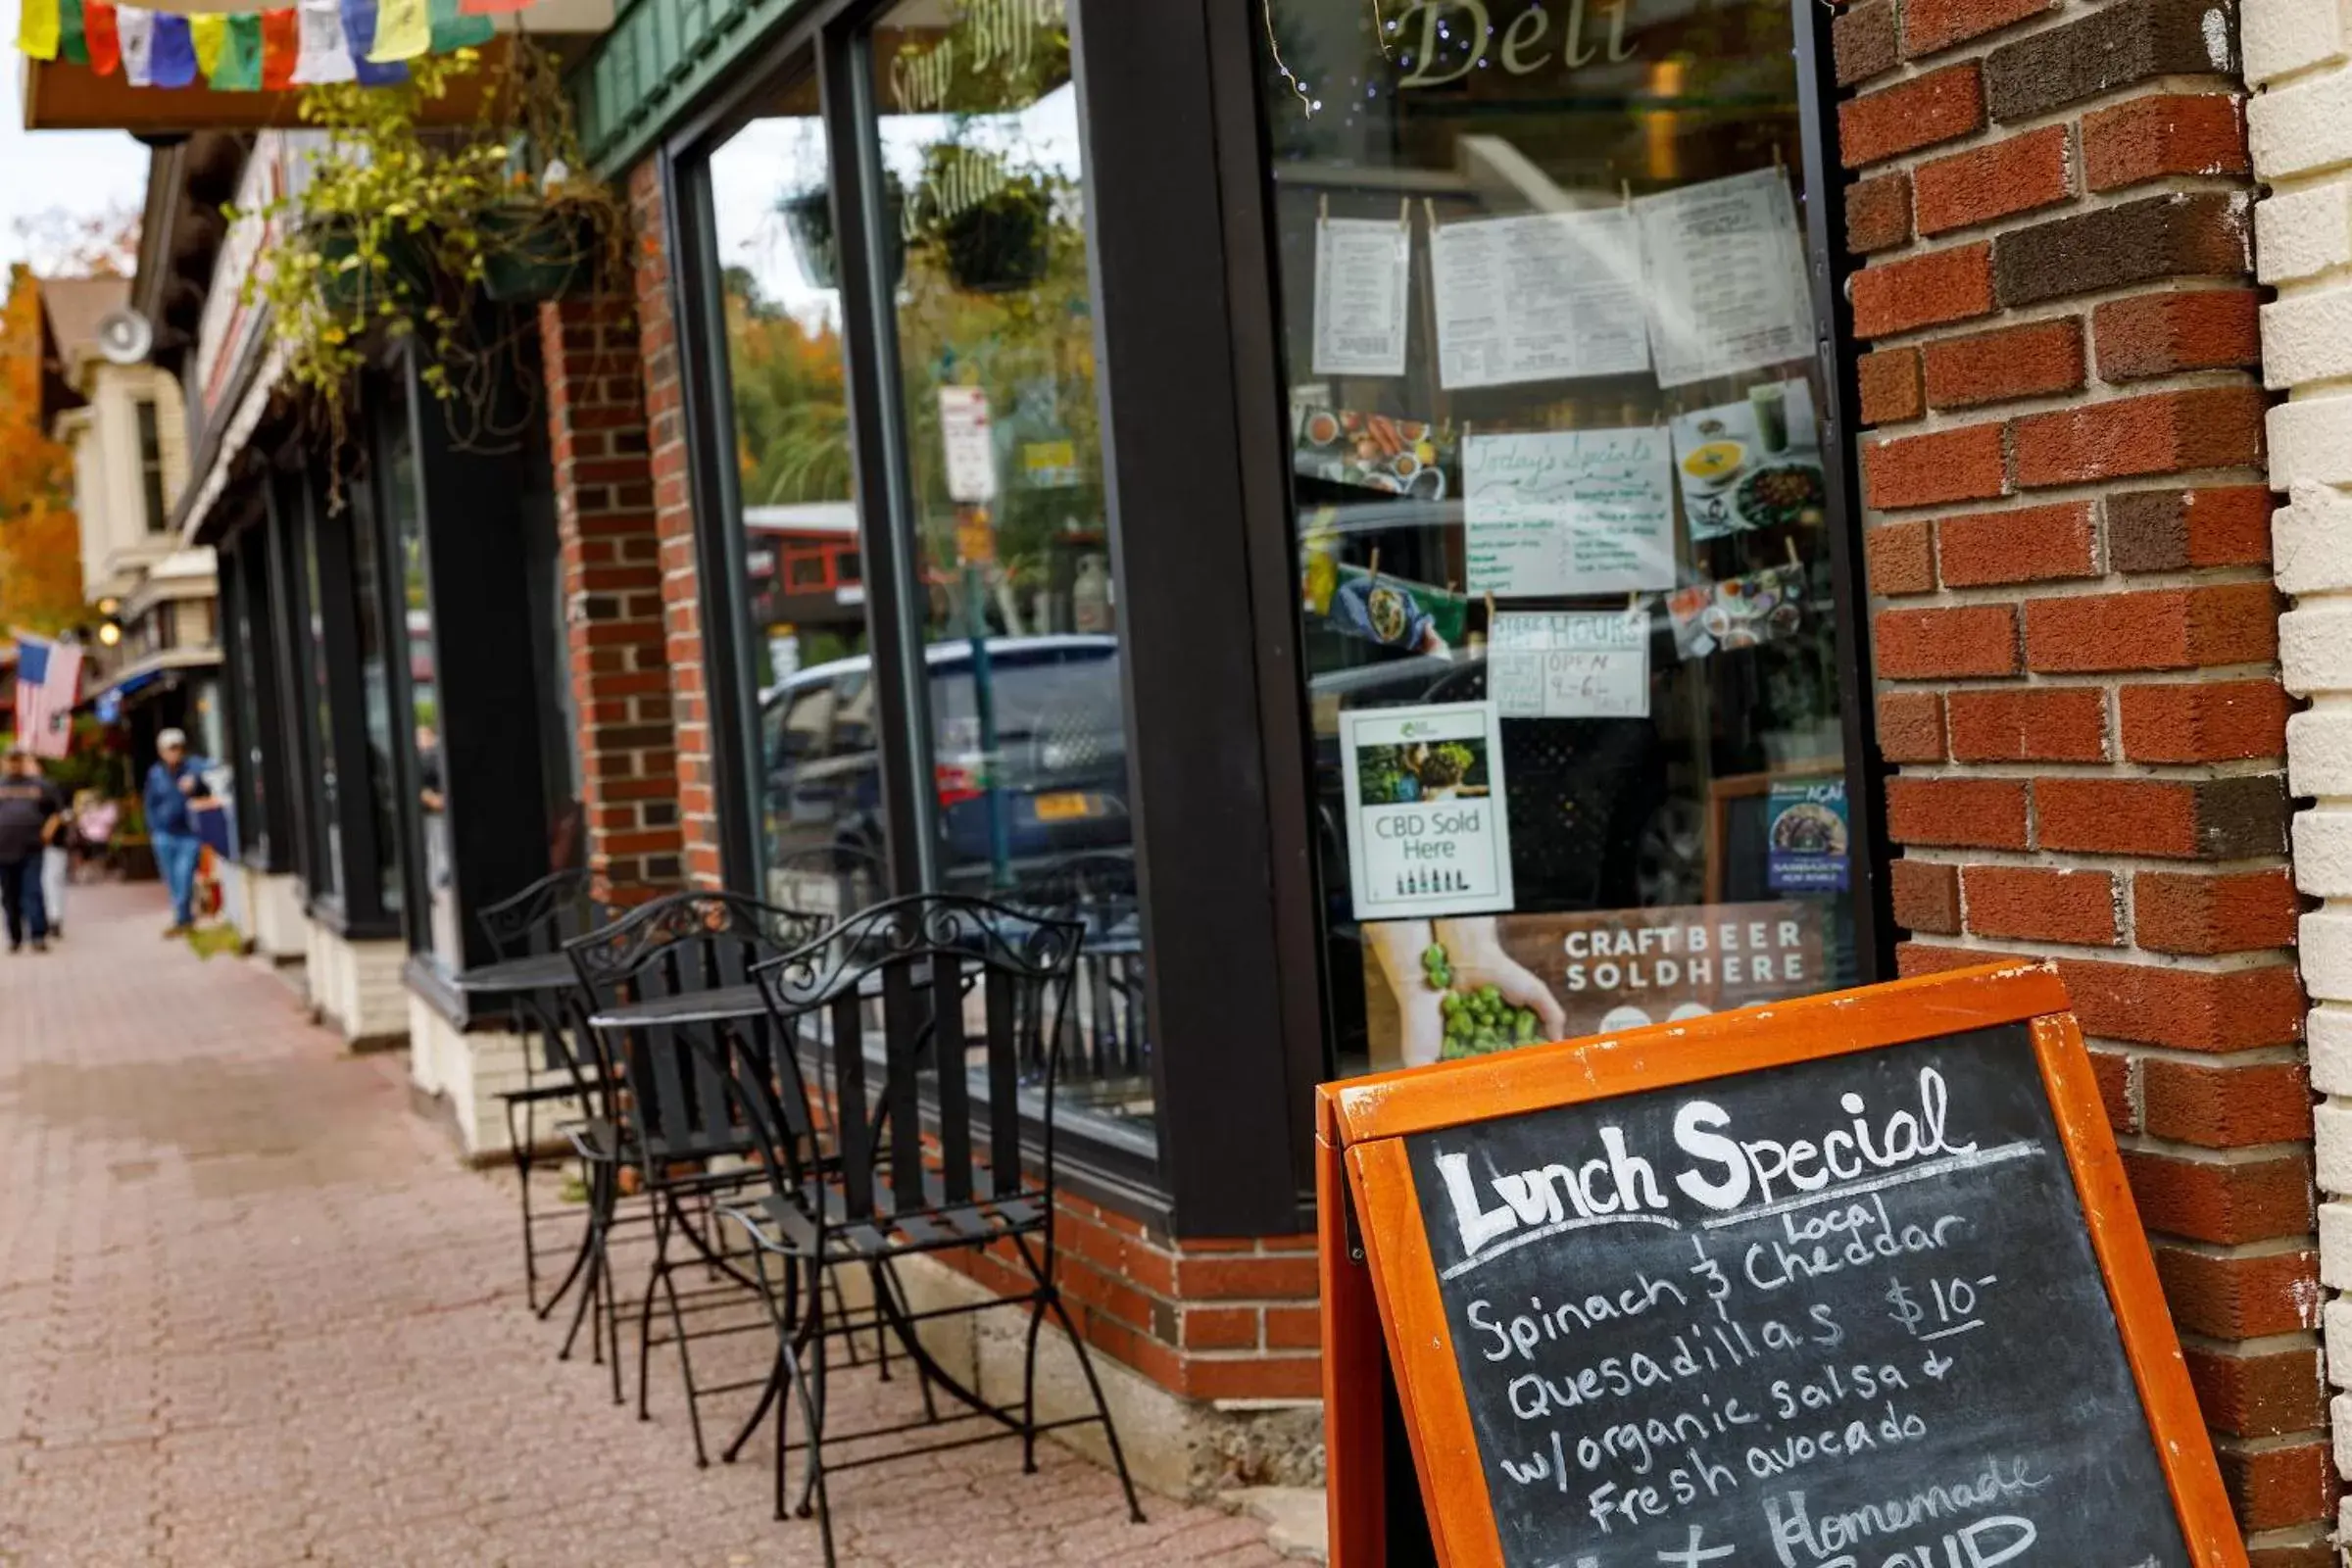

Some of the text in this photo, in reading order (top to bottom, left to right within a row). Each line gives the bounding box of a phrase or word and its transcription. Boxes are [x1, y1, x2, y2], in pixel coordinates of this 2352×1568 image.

[1396, 0, 1639, 88] Deli
[1470, 436, 1556, 488] Today's
[1375, 808, 1481, 840] CBD Sold
[1402, 838, 1456, 860] Here
[1564, 920, 1802, 958] CRAFT BEER
[1566, 953, 1803, 992] SOLD HERE
[1436, 1066, 1979, 1257] Lunch Special
[1784, 1193, 1891, 1245] Local
[1466, 1273, 1690, 1362] Spinach
[1743, 1215, 1966, 1291] Cheddar
[1507, 1302, 1846, 1420] Quesadillas
[1770, 1363, 1910, 1420] salsa
[1588, 1400, 1928, 1535] Fresh avocado
[1761, 1454, 2053, 1568] Homemade
